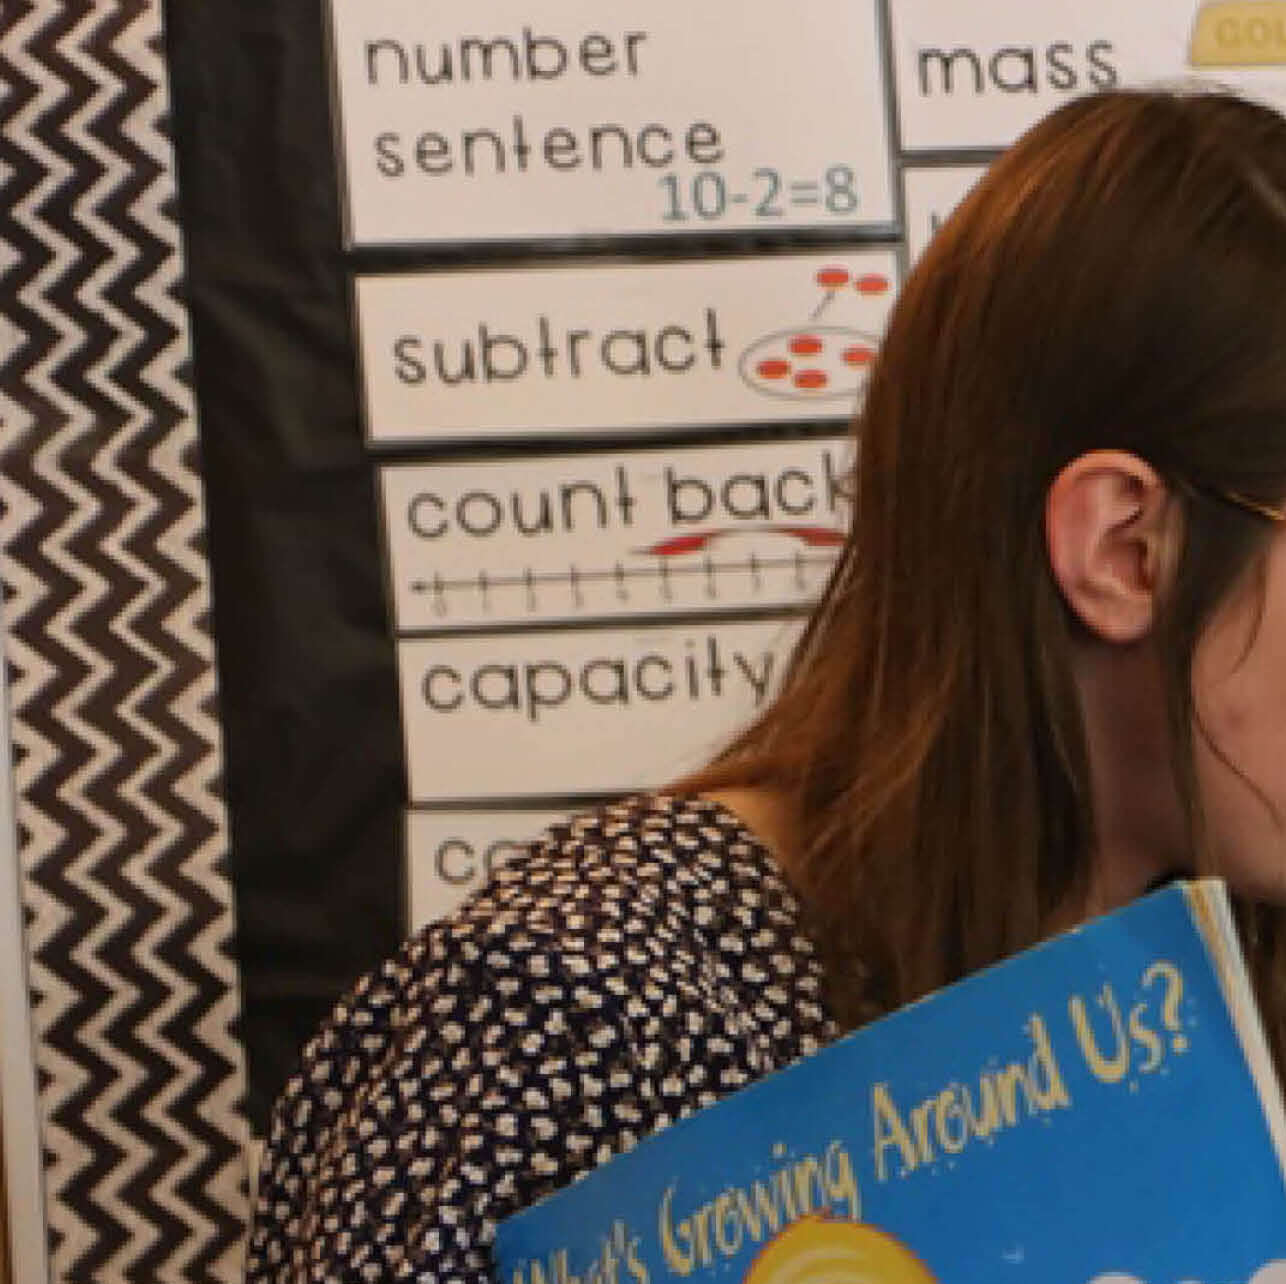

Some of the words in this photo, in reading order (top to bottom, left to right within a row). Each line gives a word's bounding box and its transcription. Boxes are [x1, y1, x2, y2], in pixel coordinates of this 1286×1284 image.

[366, 27, 648, 86] number
[918, 40, 1120, 97] mass
[375, 115, 724, 178] sentence
[660, 164, 859, 222] 10-2=8
[392, 308, 725, 387] subtract
[408, 464, 636, 538] count
[421, 636, 775, 722] capacity
[658, 1141, 863, 1278] Growing
[871, 1011, 1071, 1181] Around
[1068, 959, 1190, 1087] Us?
